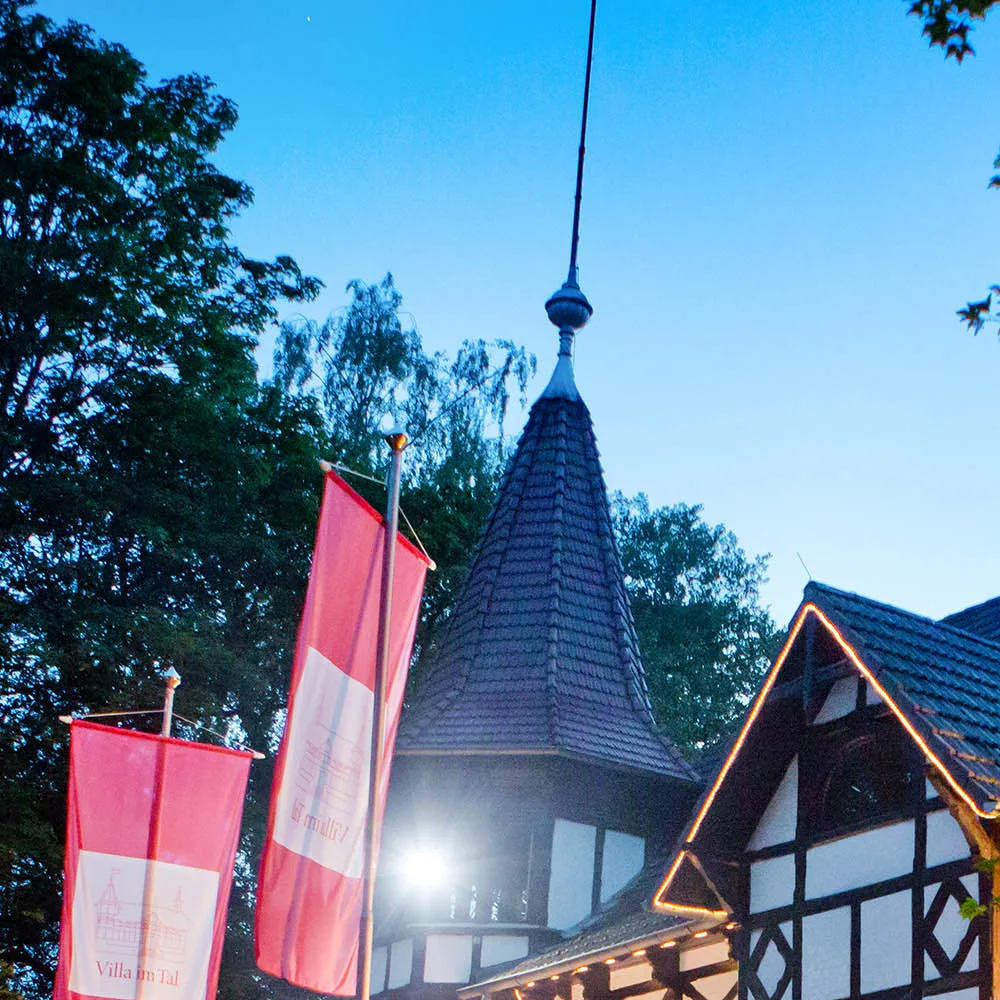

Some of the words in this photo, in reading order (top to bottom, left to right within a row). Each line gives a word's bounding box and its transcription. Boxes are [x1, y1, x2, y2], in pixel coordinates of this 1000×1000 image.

[96, 960, 132, 979] Villa
[136, 964, 155, 982] im
[157, 968, 179, 986] Tal
